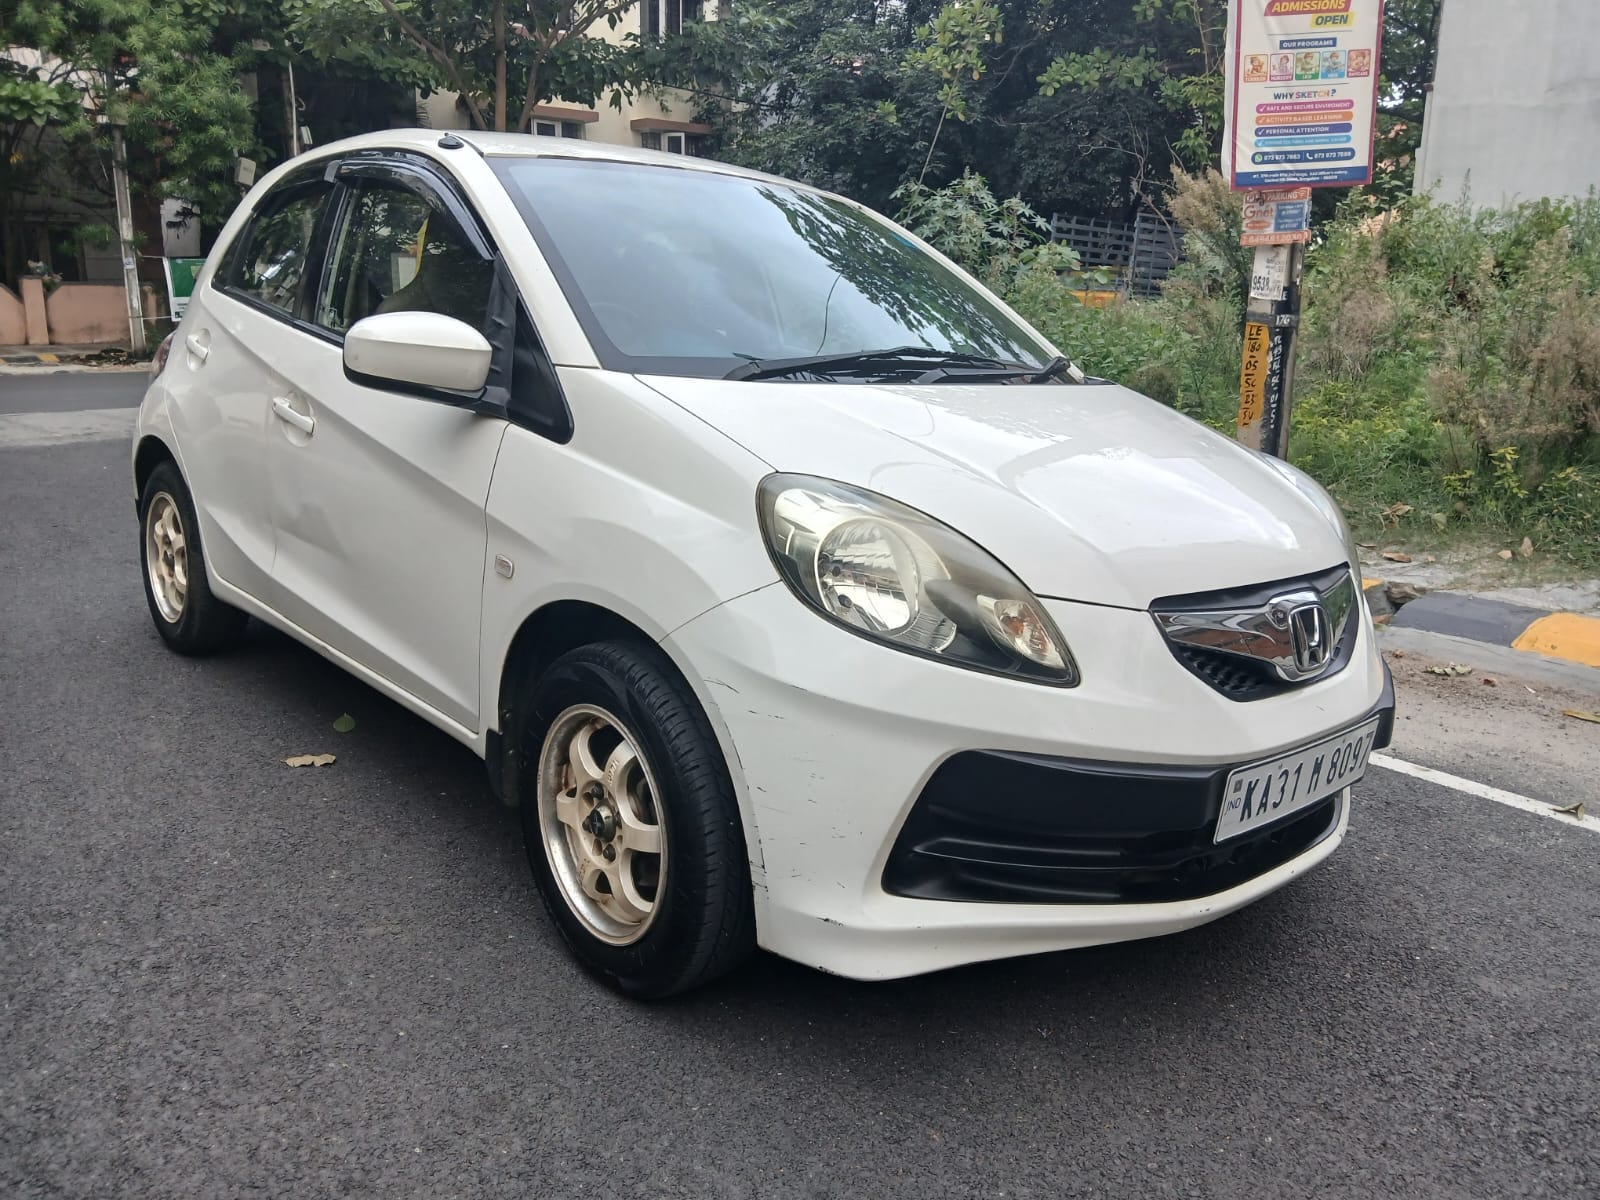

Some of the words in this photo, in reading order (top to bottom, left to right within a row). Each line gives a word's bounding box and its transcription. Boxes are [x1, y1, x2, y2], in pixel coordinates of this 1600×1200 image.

[1271, 0, 1346, 13] ADMISSIONS
[1315, 14, 1349, 26] OPEN
[1273, 91, 1294, 100] WHY
[1240, 762, 1303, 822] KA31
[1326, 730, 1375, 785] 8097
[1227, 797, 1241, 811] IND
